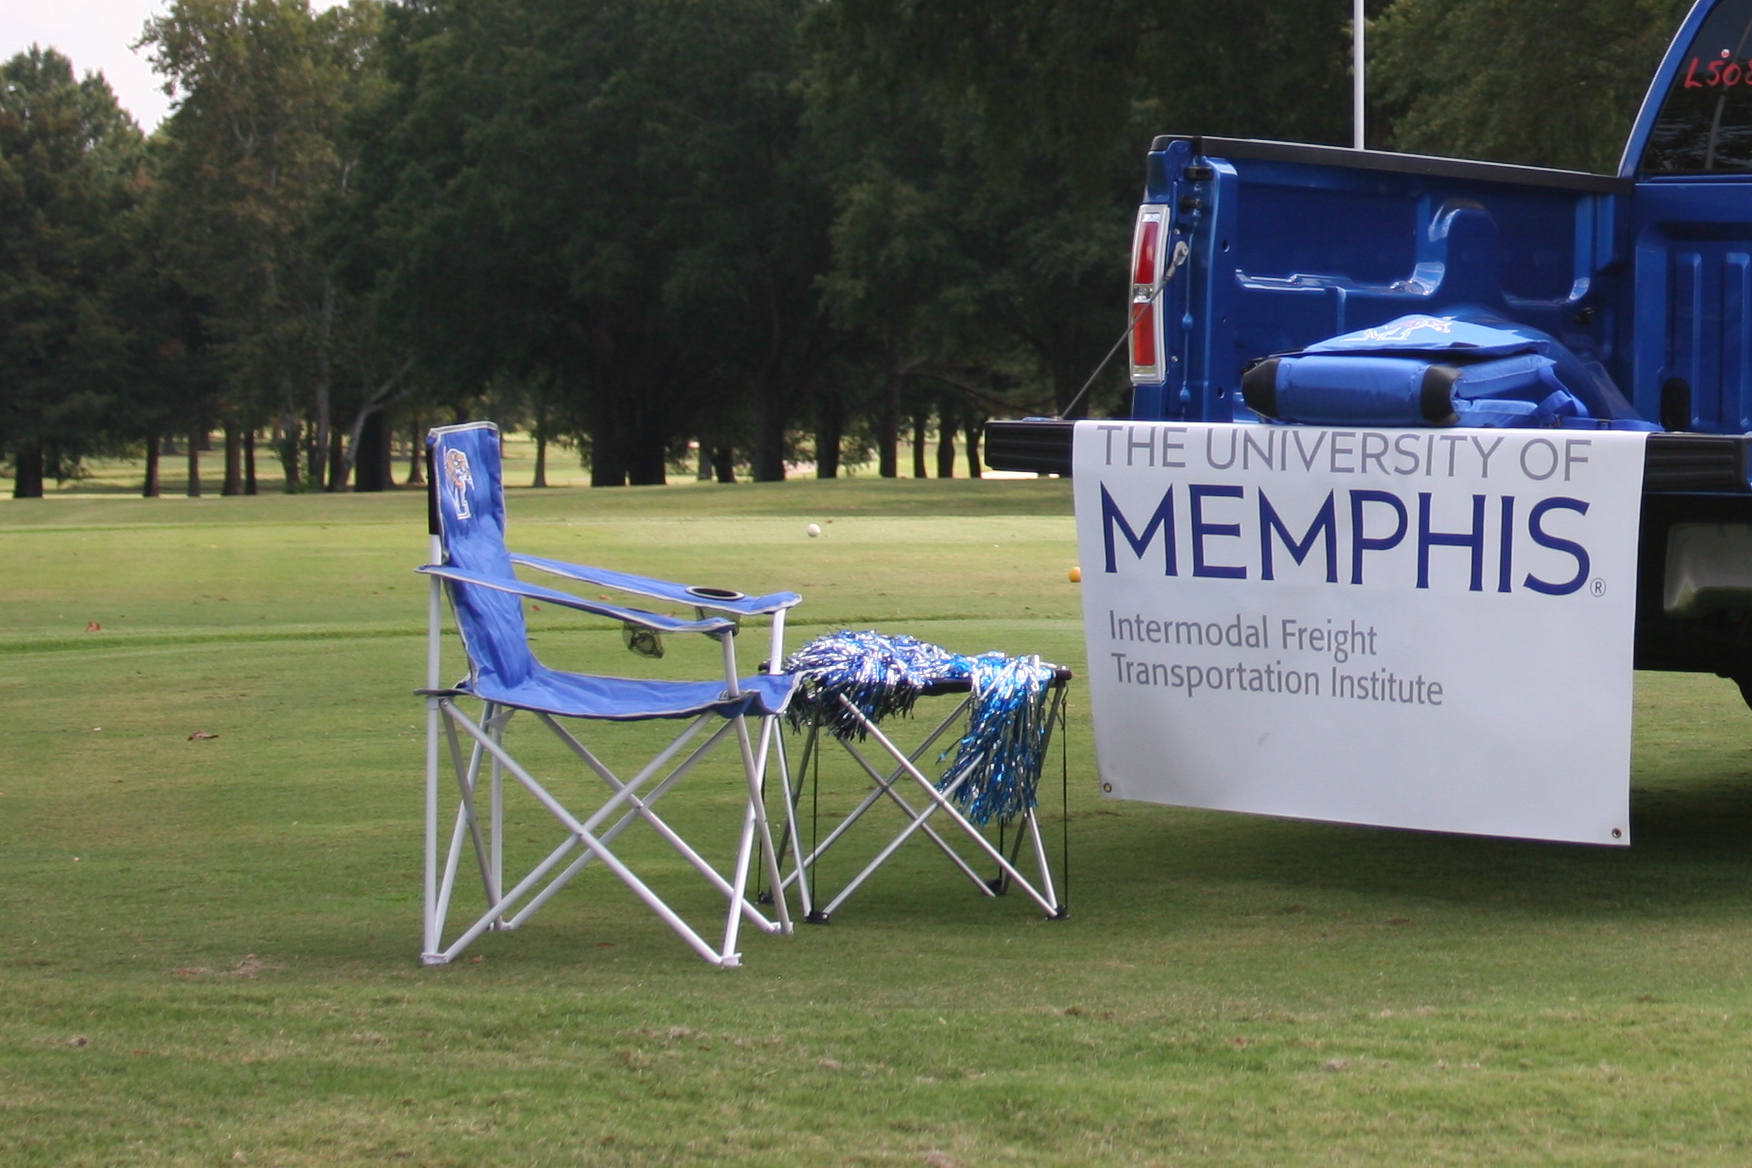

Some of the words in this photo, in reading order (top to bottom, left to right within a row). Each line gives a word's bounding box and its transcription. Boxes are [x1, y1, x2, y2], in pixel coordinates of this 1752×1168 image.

[1097, 425, 1188, 469] THE
[1206, 427, 1505, 480] UNIVERSITY
[1519, 437, 1594, 482] OF
[1109, 610, 1269, 650] Intermodal
[1281, 618, 1378, 664] Freight
[1111, 653, 1321, 698] Transportation
[1331, 666, 1445, 706] Institute
